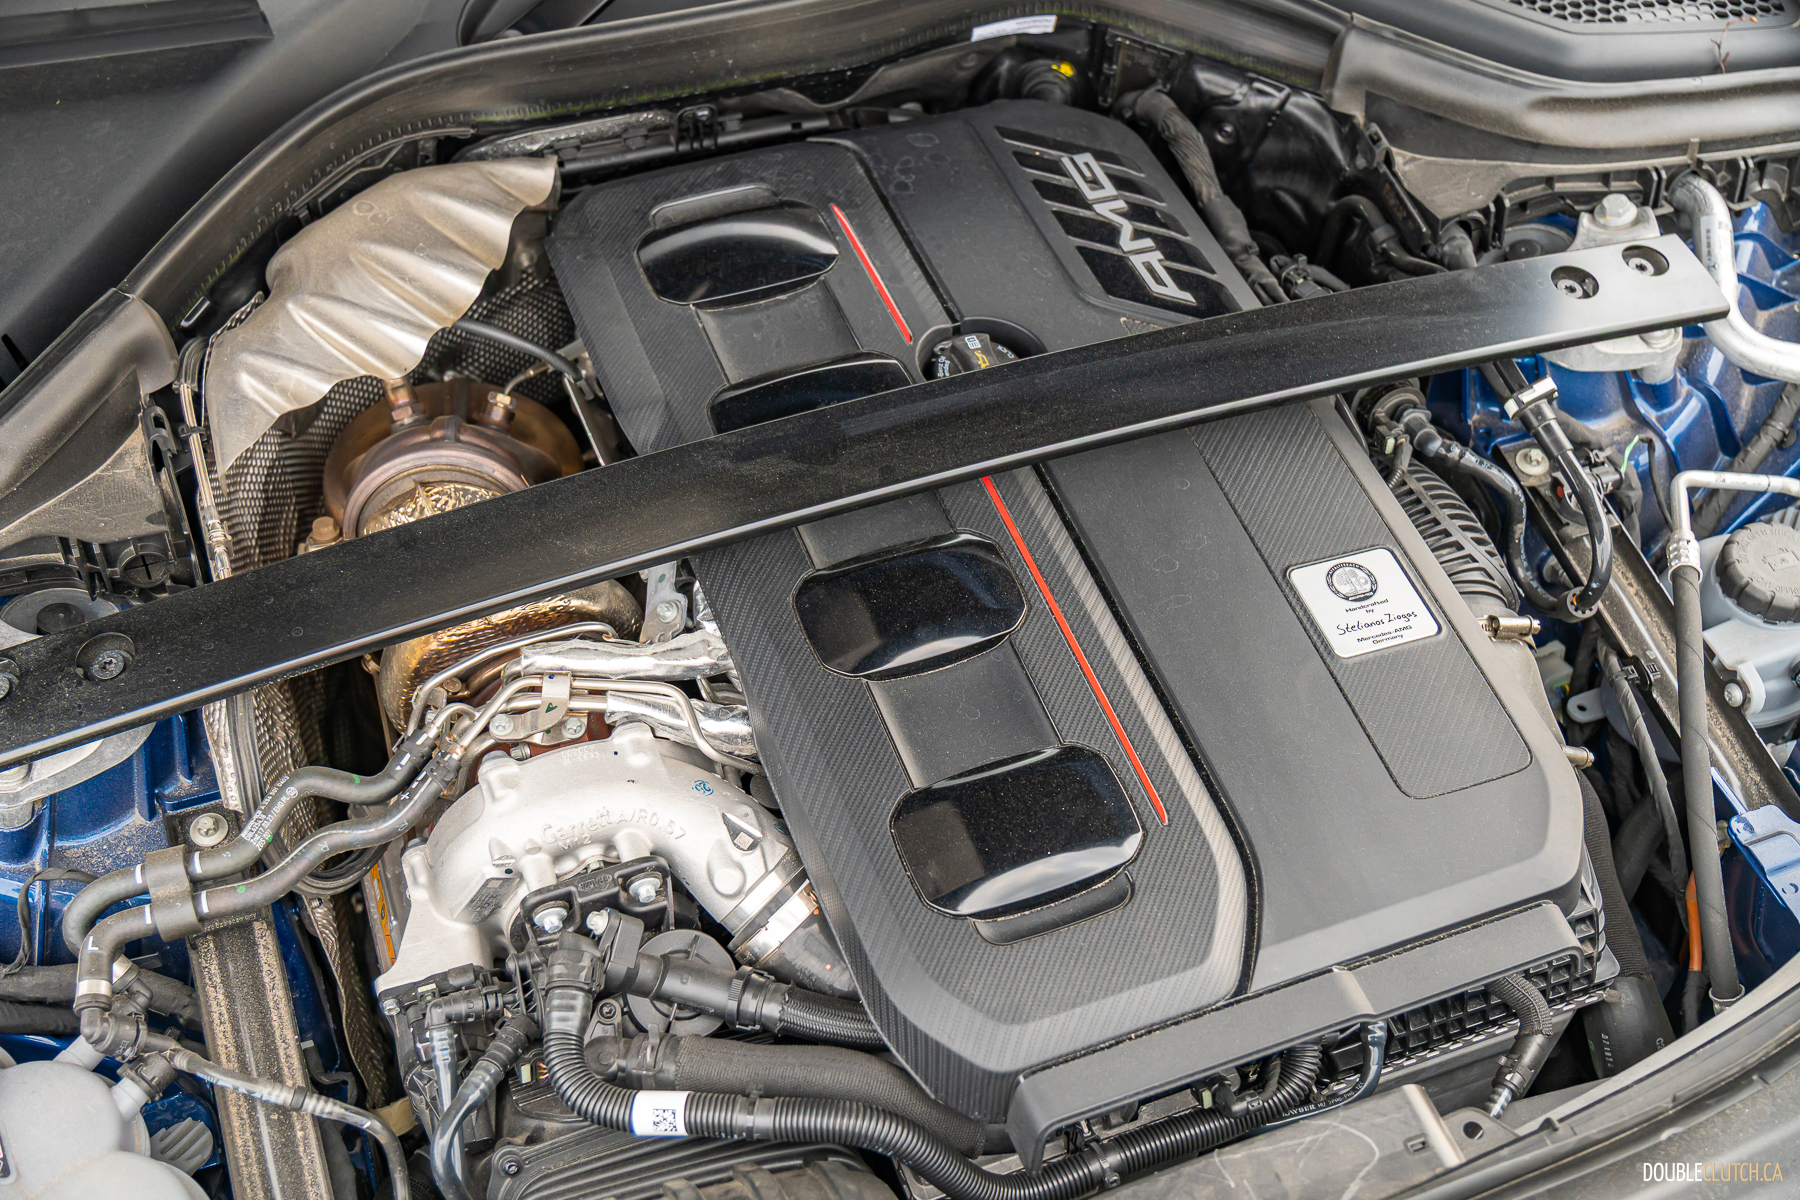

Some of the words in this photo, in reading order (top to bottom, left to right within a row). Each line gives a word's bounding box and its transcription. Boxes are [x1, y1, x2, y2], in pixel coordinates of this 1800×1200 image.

[1061, 151, 1197, 305] AMG
[1345, 598, 1389, 613] Handcrafted
[1384, 611, 1418, 623] Ziogas
[1356, 624, 1413, 643] Mercedes-AMG
[1372, 633, 1404, 645] Germany
[541, 806, 612, 844] Garrett
